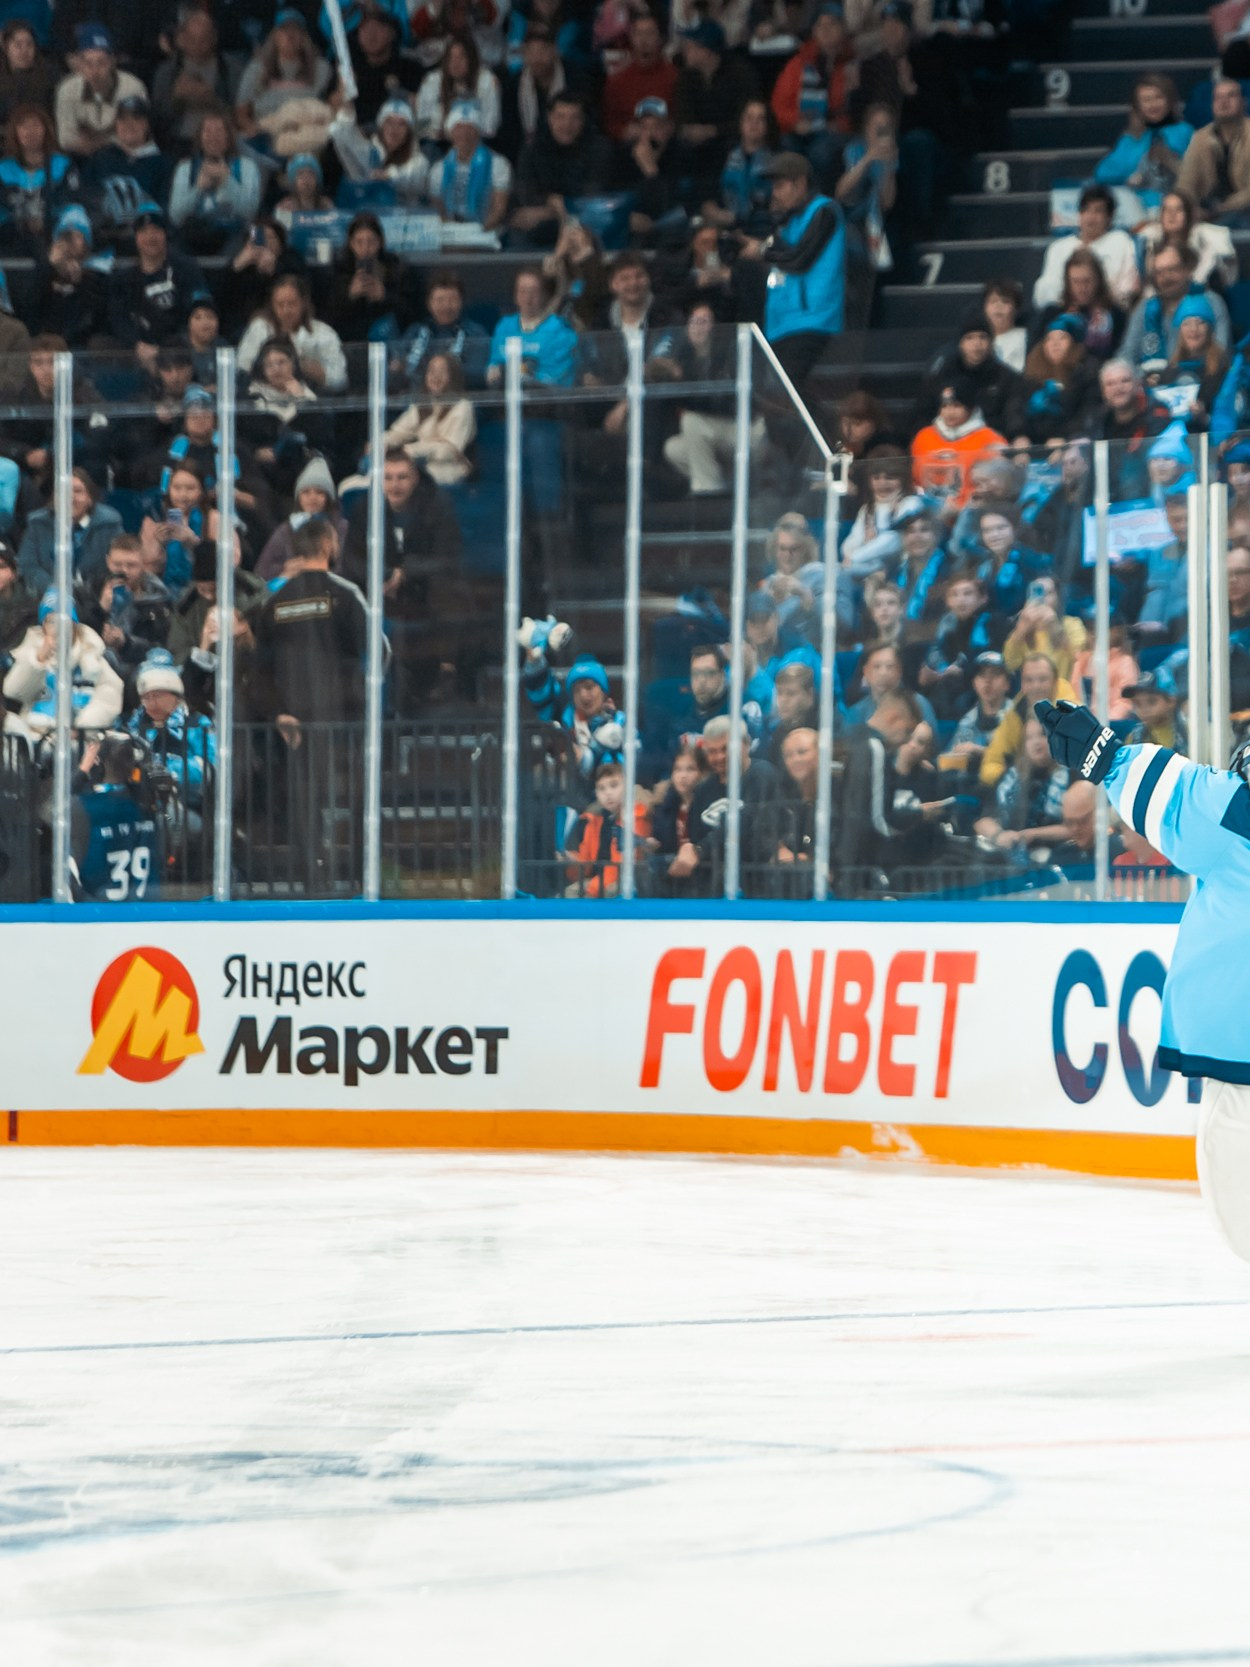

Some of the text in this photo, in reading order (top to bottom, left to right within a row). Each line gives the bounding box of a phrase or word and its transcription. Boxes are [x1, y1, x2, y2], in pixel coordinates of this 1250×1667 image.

[1045, 68, 1071, 100] 9
[984, 161, 1010, 193] 8
[919, 252, 945, 286] 7
[106, 846, 150, 901] 39
[223, 953, 367, 1005] Яндекс
[639, 946, 978, 1098] FONBET
[218, 1014, 509, 1087] Маркет
